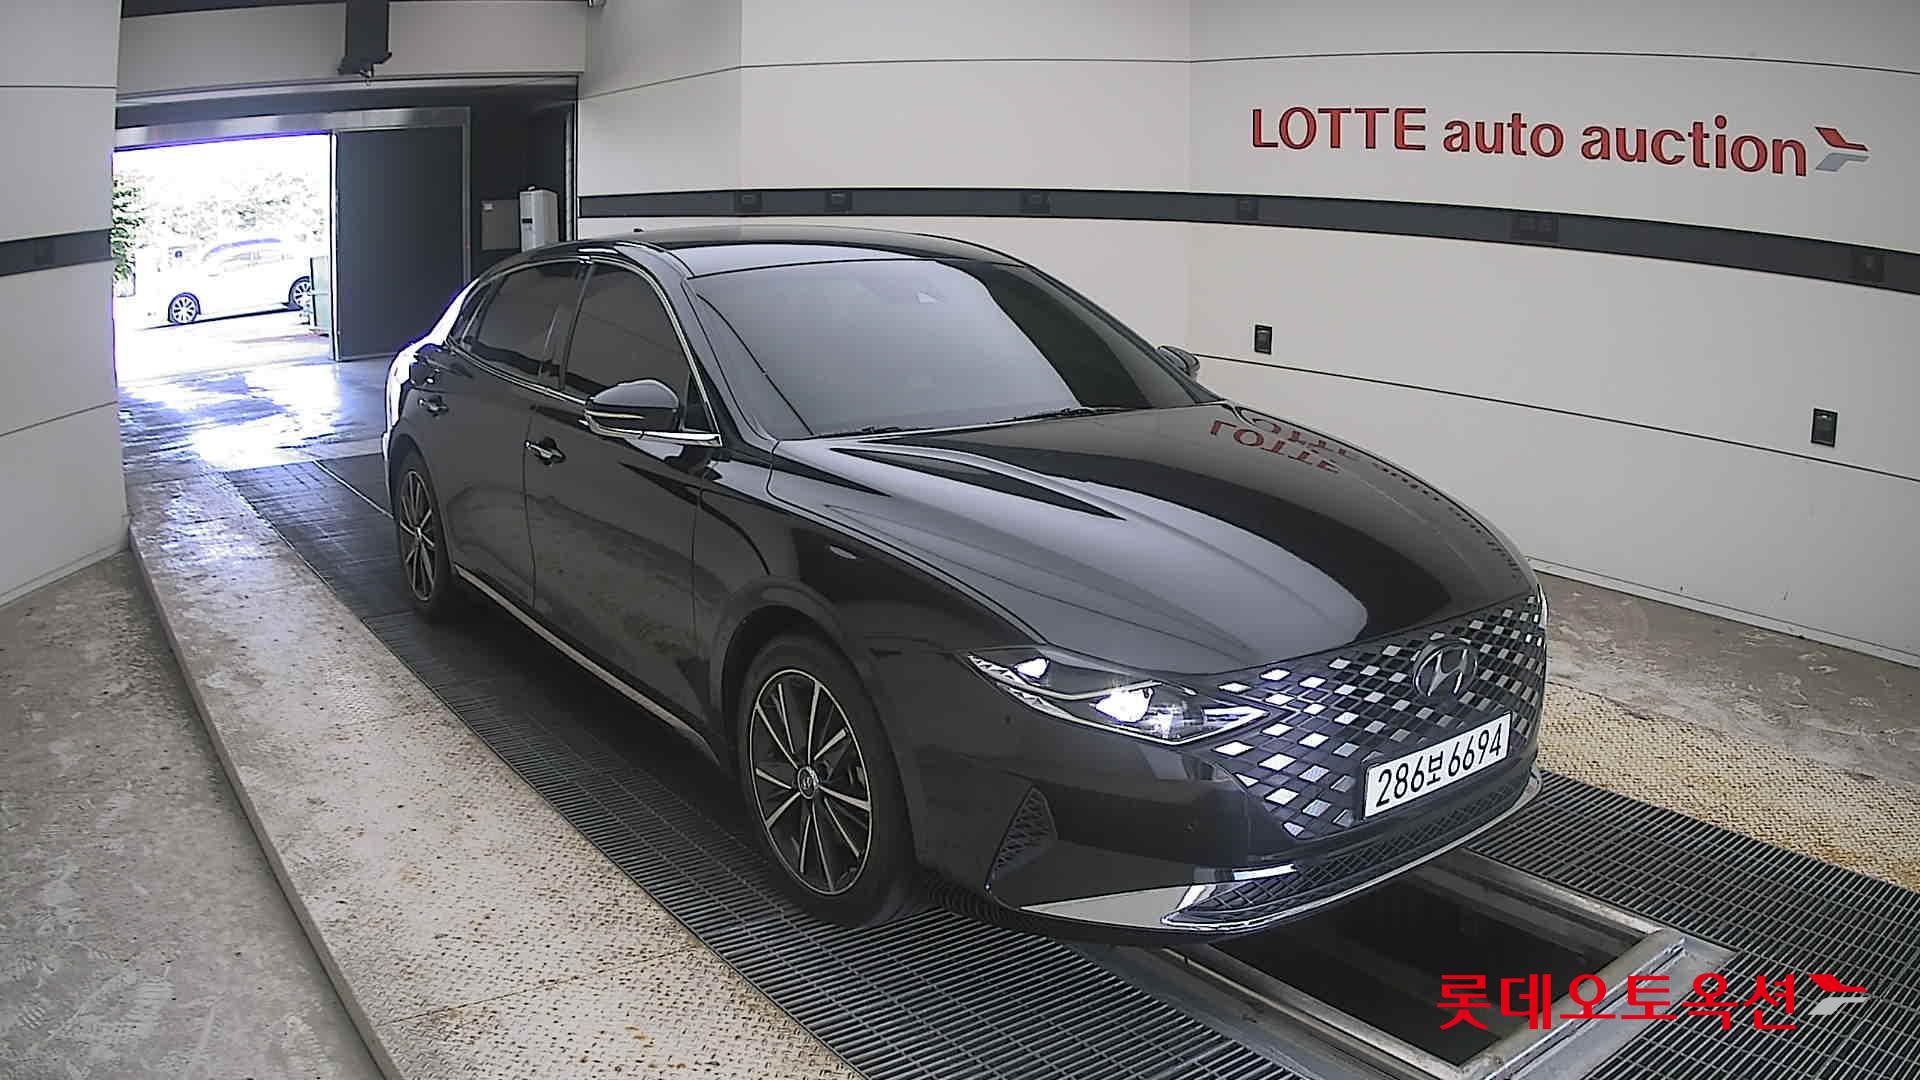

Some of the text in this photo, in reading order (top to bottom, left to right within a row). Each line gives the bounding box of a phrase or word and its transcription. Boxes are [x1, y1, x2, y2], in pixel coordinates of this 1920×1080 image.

[1252, 105, 1808, 177] LOTTE auto auction
